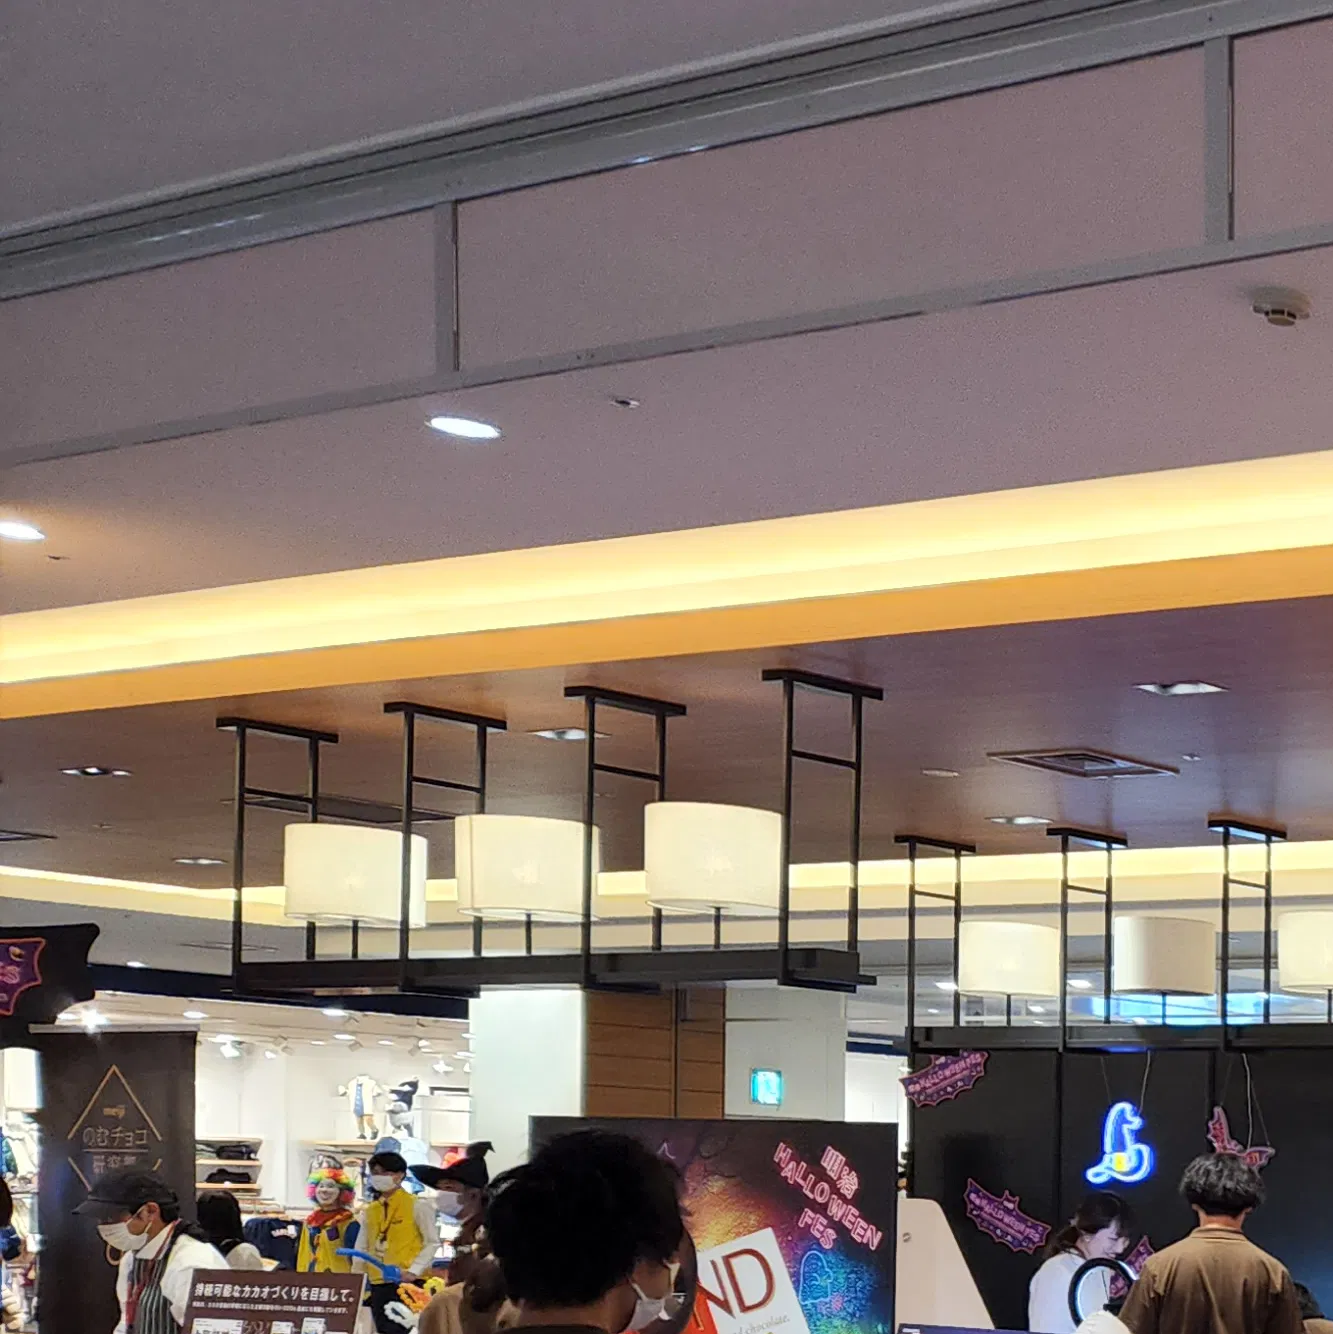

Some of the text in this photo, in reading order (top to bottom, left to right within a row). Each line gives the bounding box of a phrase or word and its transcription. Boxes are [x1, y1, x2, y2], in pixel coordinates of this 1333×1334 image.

[773, 1142, 882, 1251] HALLOWEEN
[798, 1208, 837, 1249] FES
[693, 1248, 776, 1331] ND
